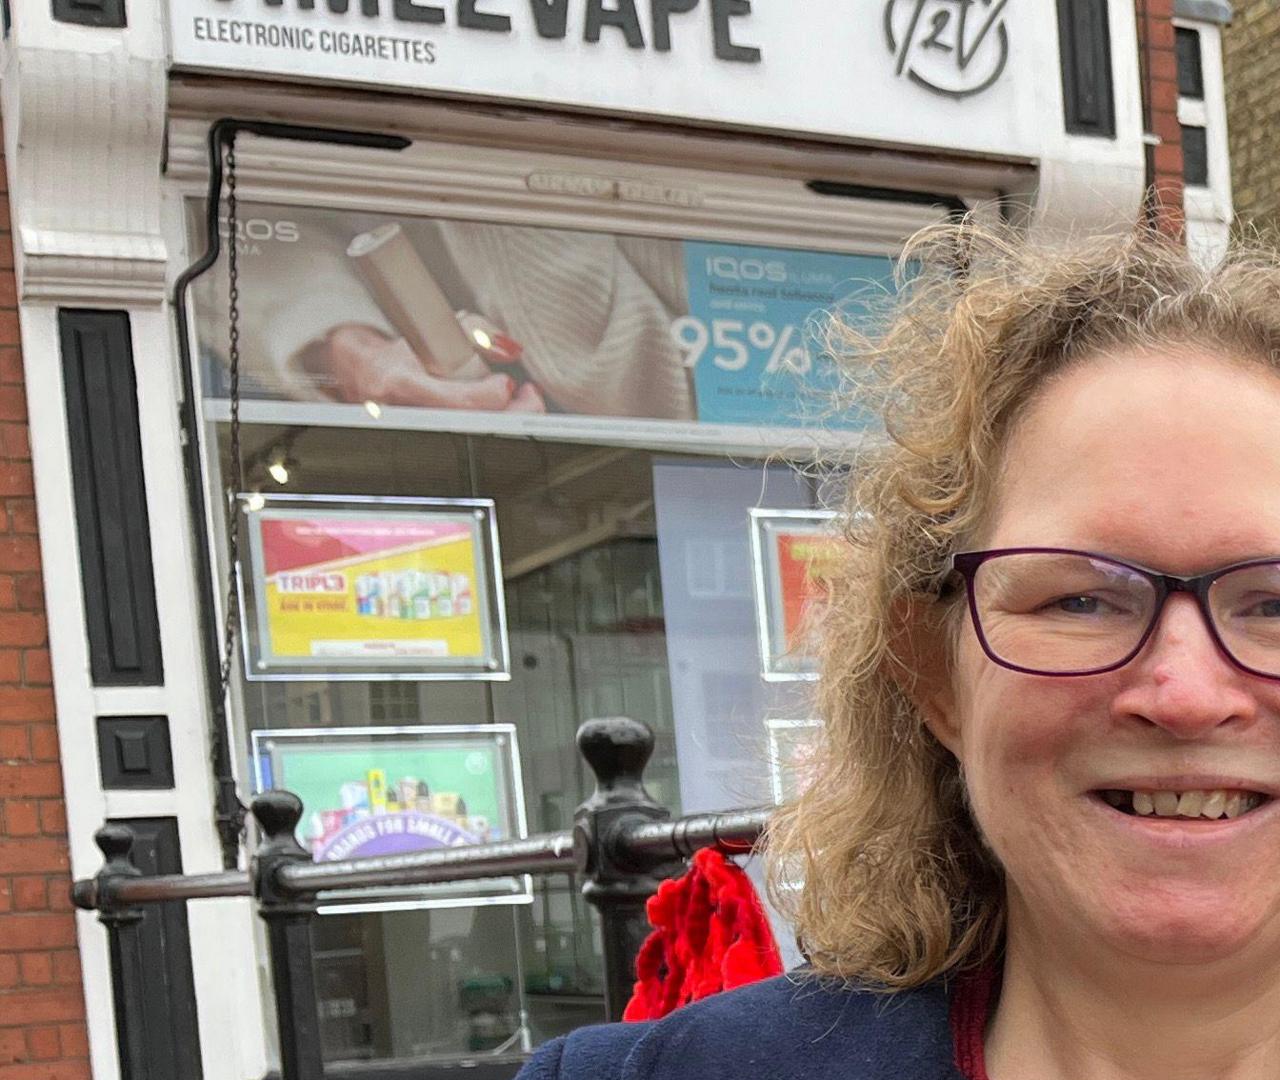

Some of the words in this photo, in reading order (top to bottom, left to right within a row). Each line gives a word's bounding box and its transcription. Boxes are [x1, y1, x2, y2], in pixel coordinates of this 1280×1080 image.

[193, 17, 315, 51] ELECTRONIC
[320, 32, 437, 63] CIGARETTES
[218, 217, 299, 243] QOS
[706, 256, 788, 282] IQOS
[670, 315, 812, 375] 95%
